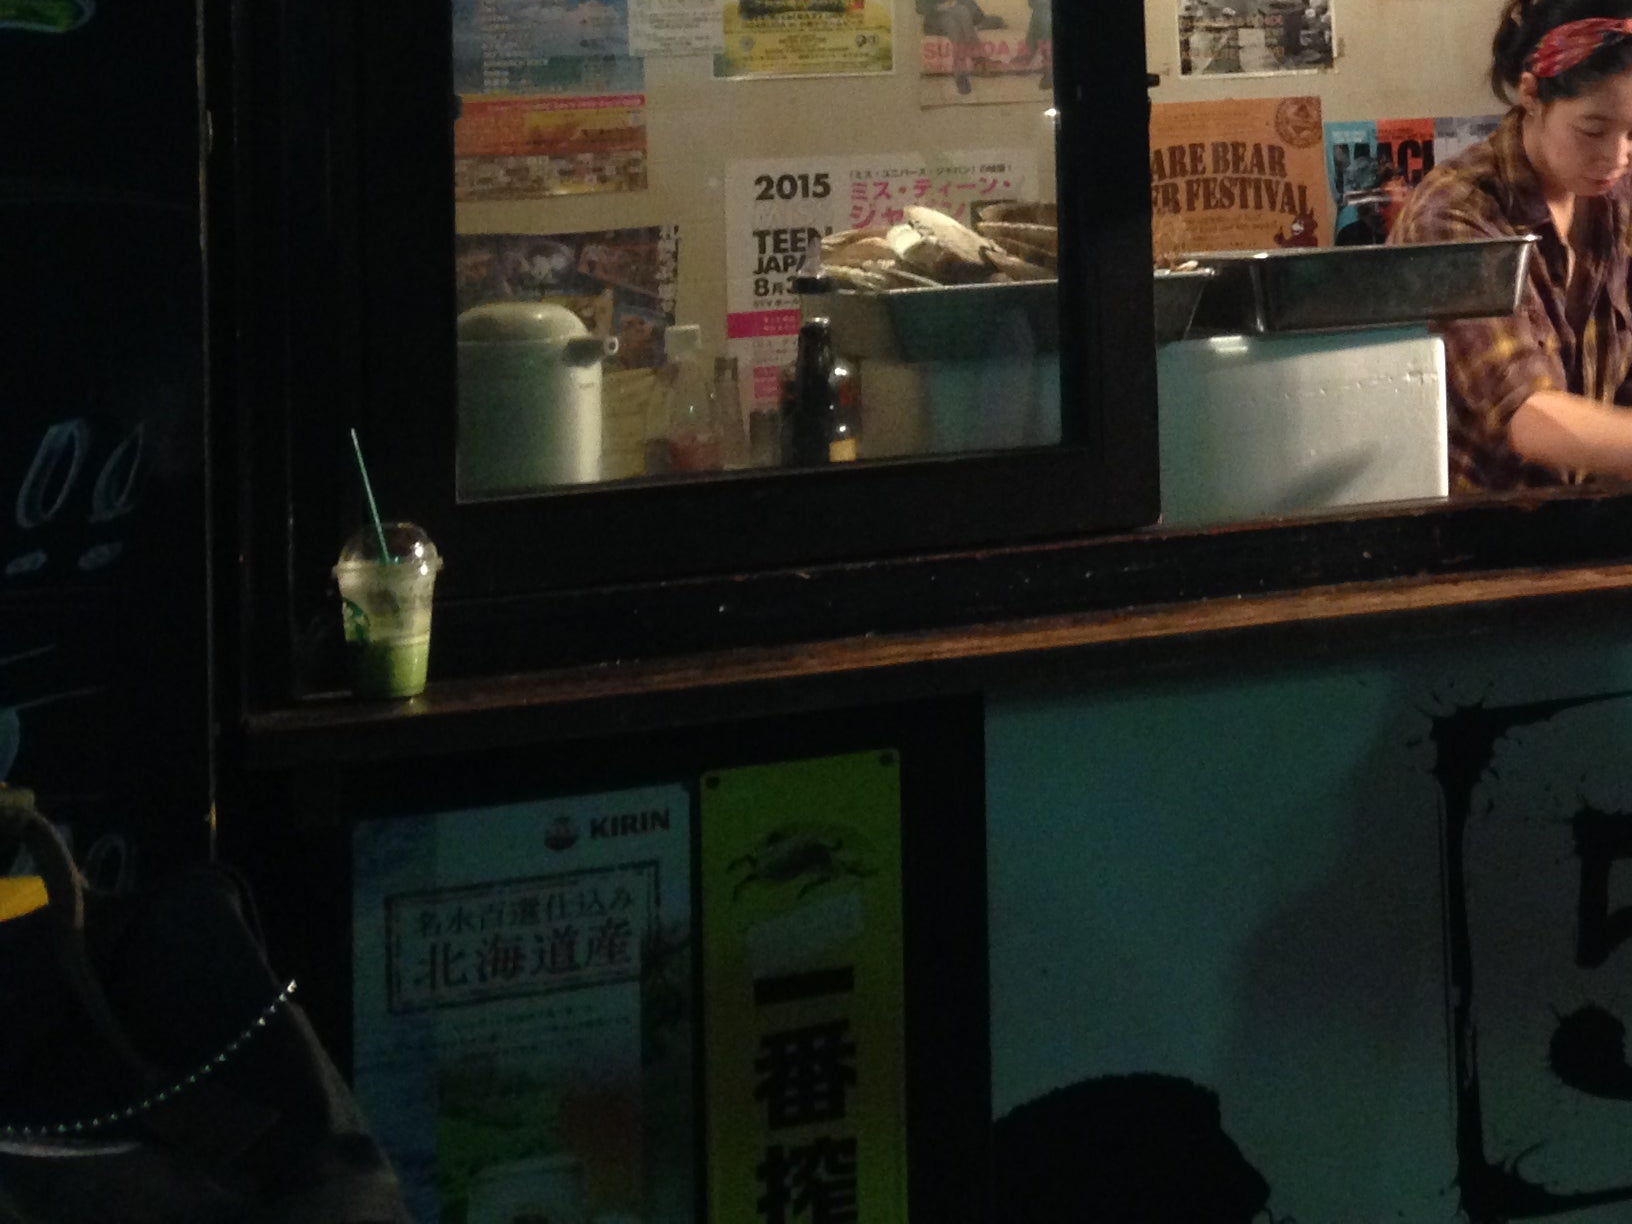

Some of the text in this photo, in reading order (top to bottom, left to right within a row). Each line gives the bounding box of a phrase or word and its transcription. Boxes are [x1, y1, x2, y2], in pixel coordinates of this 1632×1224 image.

[1211, 141, 1287, 178] BEAR
[754, 173, 831, 201] 2015
[1184, 176, 1307, 217] FESTIVAL
[590, 808, 670, 840] KIRIN
[420, 918, 634, 993] 北海道産
